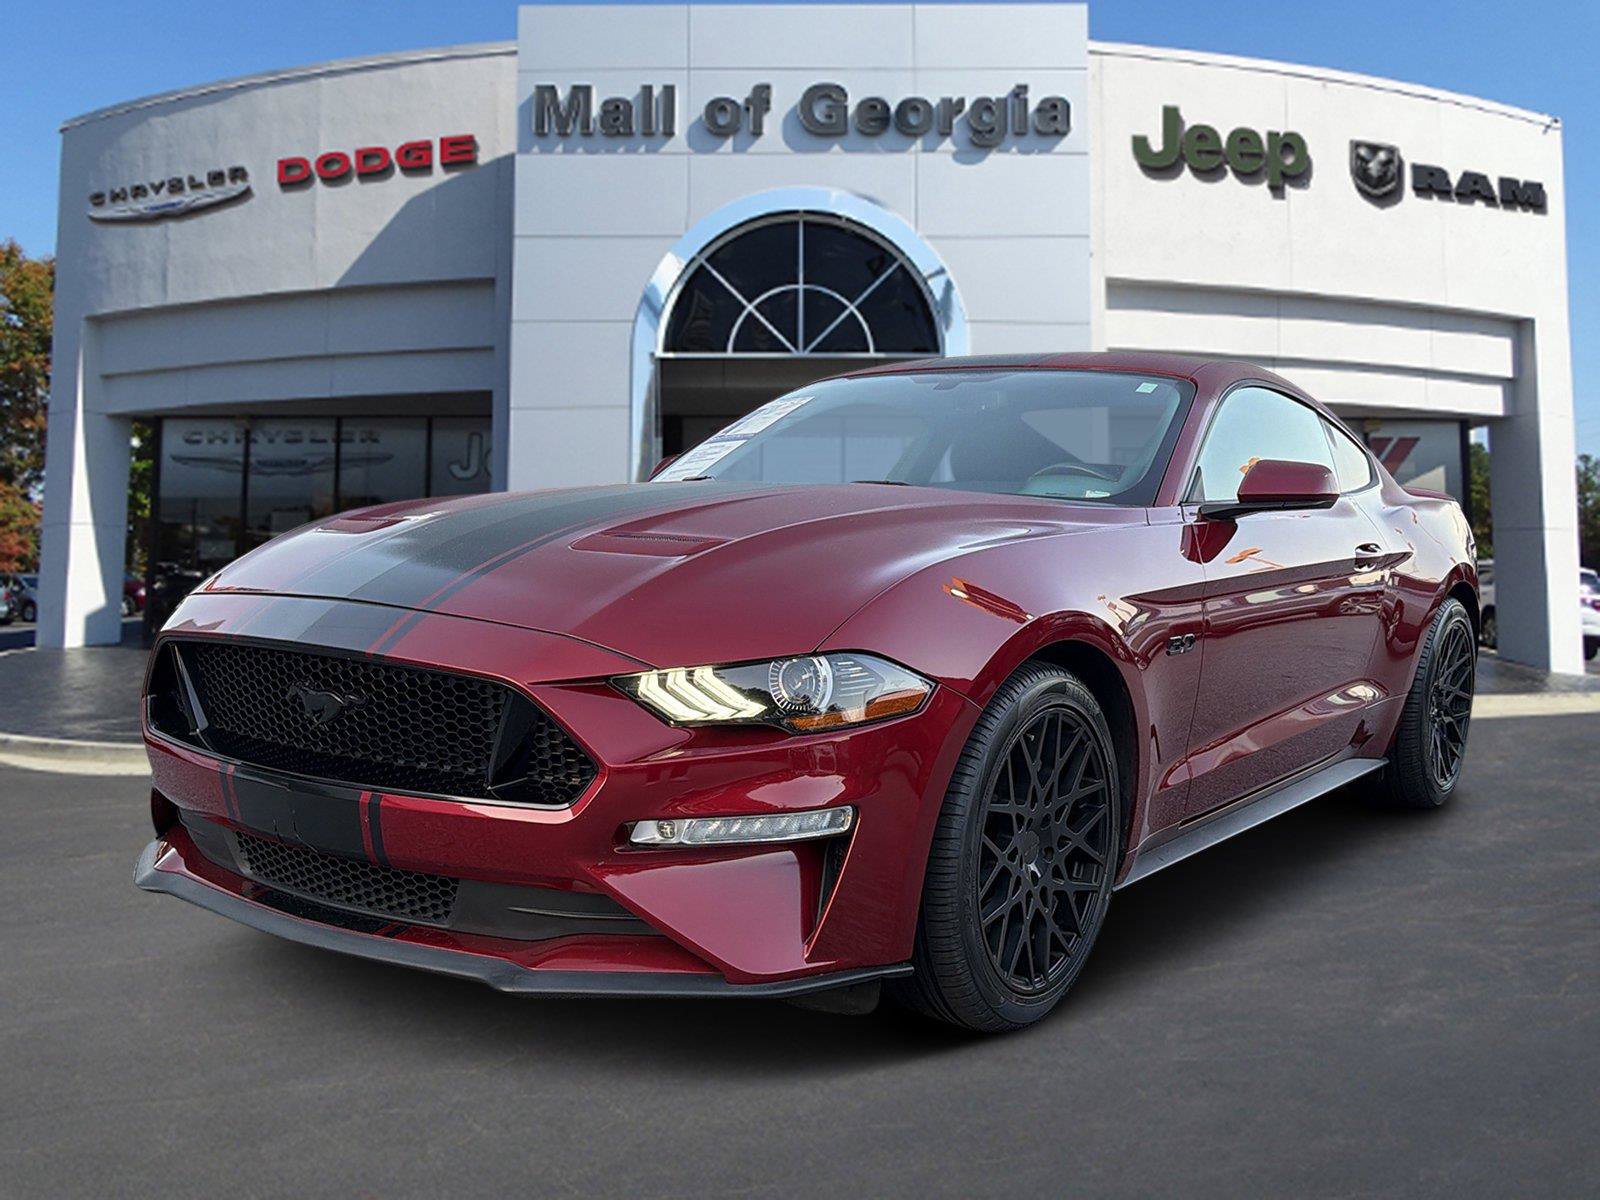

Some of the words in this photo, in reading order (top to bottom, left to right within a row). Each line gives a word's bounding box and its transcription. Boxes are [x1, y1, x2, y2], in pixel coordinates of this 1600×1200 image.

[533, 83, 677, 138] Mall
[704, 83, 772, 137] of
[799, 82, 1071, 149] Georgia
[277, 134, 478, 190] DODGE
[1131, 105, 1311, 197] Jeep
[88, 166, 249, 207] CHRYSLER
[1410, 162, 1549, 214] RAM
[447, 432, 493, 481] J
